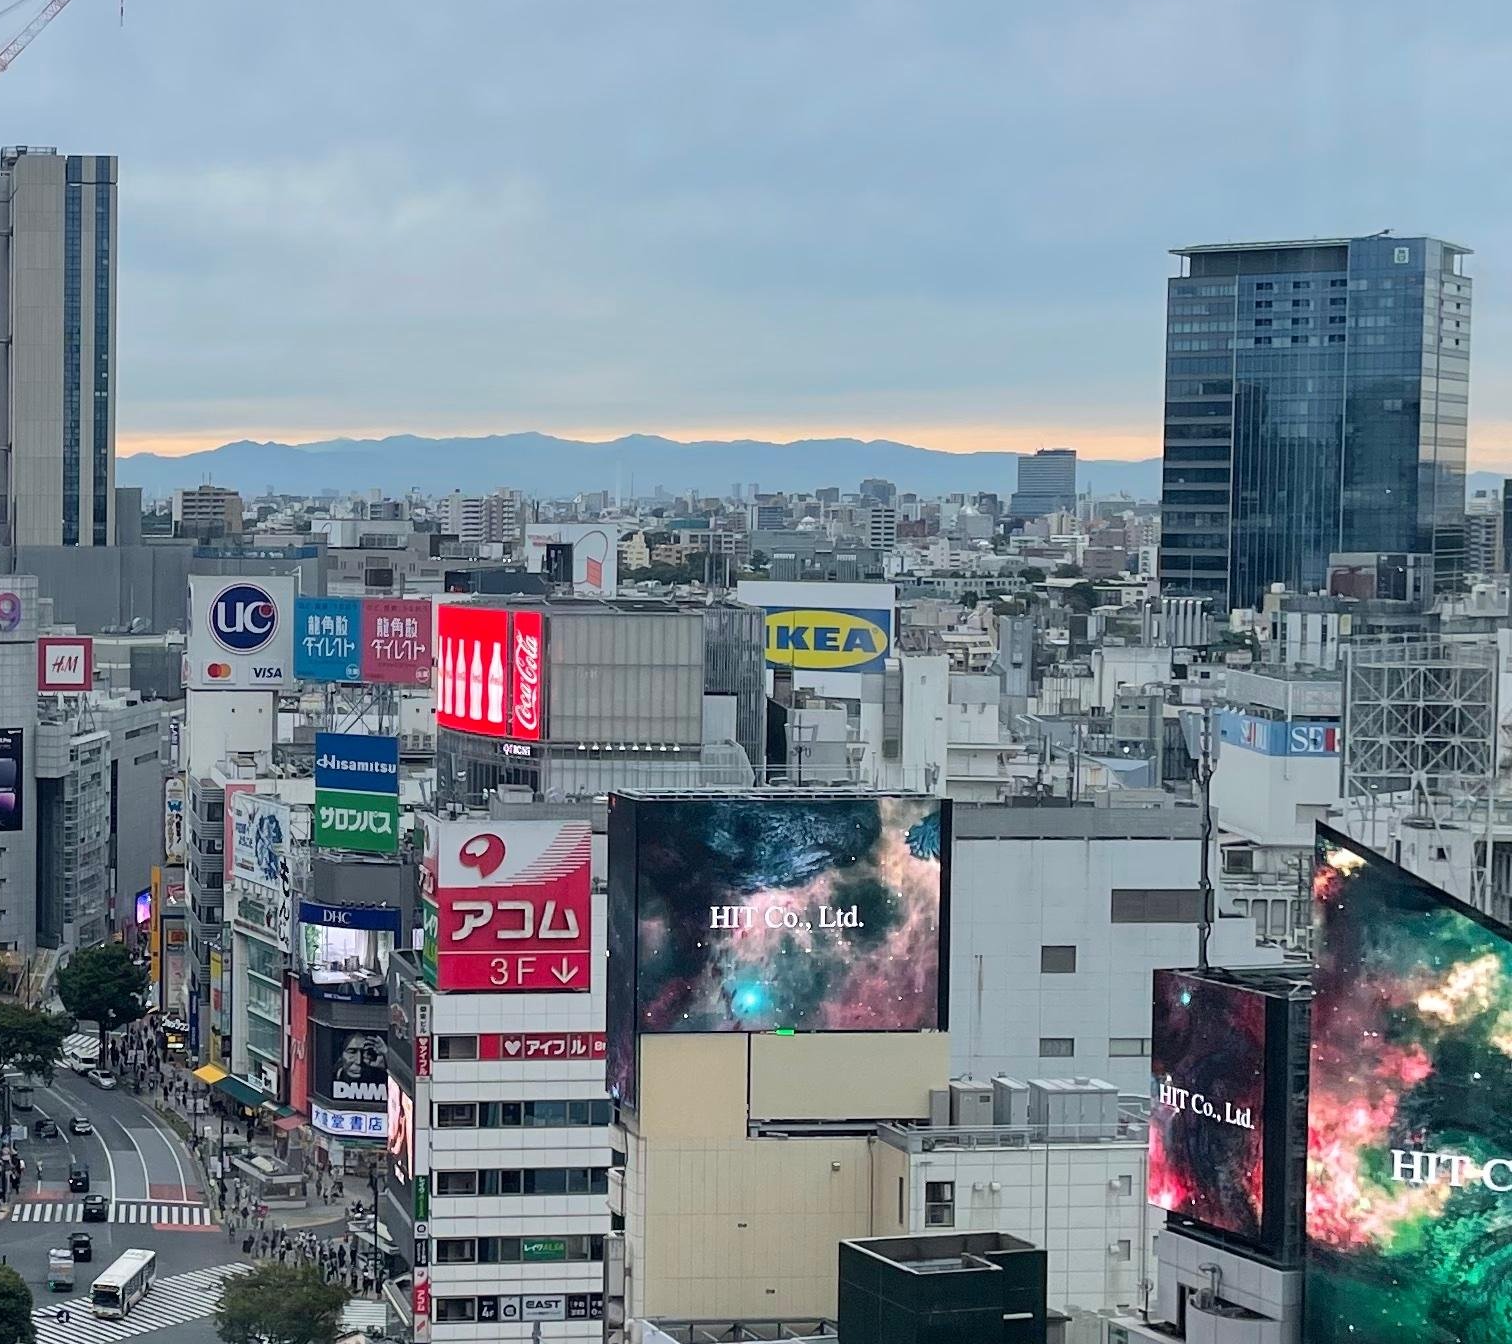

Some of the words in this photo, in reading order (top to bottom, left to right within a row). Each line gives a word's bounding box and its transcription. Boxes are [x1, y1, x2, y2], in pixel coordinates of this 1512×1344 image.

[766, 625, 876, 652] IKEA
[52, 655, 78, 674] H&M
[253, 667, 283, 679] VISA
[316, 754, 397, 774] Hisamitsu
[320, 806, 392, 835] サロンパス
[323, 909, 353, 924] DHC
[451, 900, 580, 941] アコム
[710, 905, 756, 929] HIT
[764, 905, 813, 931] Co.,
[818, 904, 864, 929] Ltd.
[490, 957, 537, 985] 3F
[525, 1039, 587, 1055] アイフル
[418, 1046, 428, 1076] アイフル
[333, 1081, 388, 1100] DMM
[1158, 1083, 1189, 1109] HIT
[1191, 1094, 1222, 1123] Co.,
[1225, 1102, 1255, 1130] Ltd.
[1390, 1149, 1473, 1188] HIT
[525, 1299, 562, 1310] EAST
